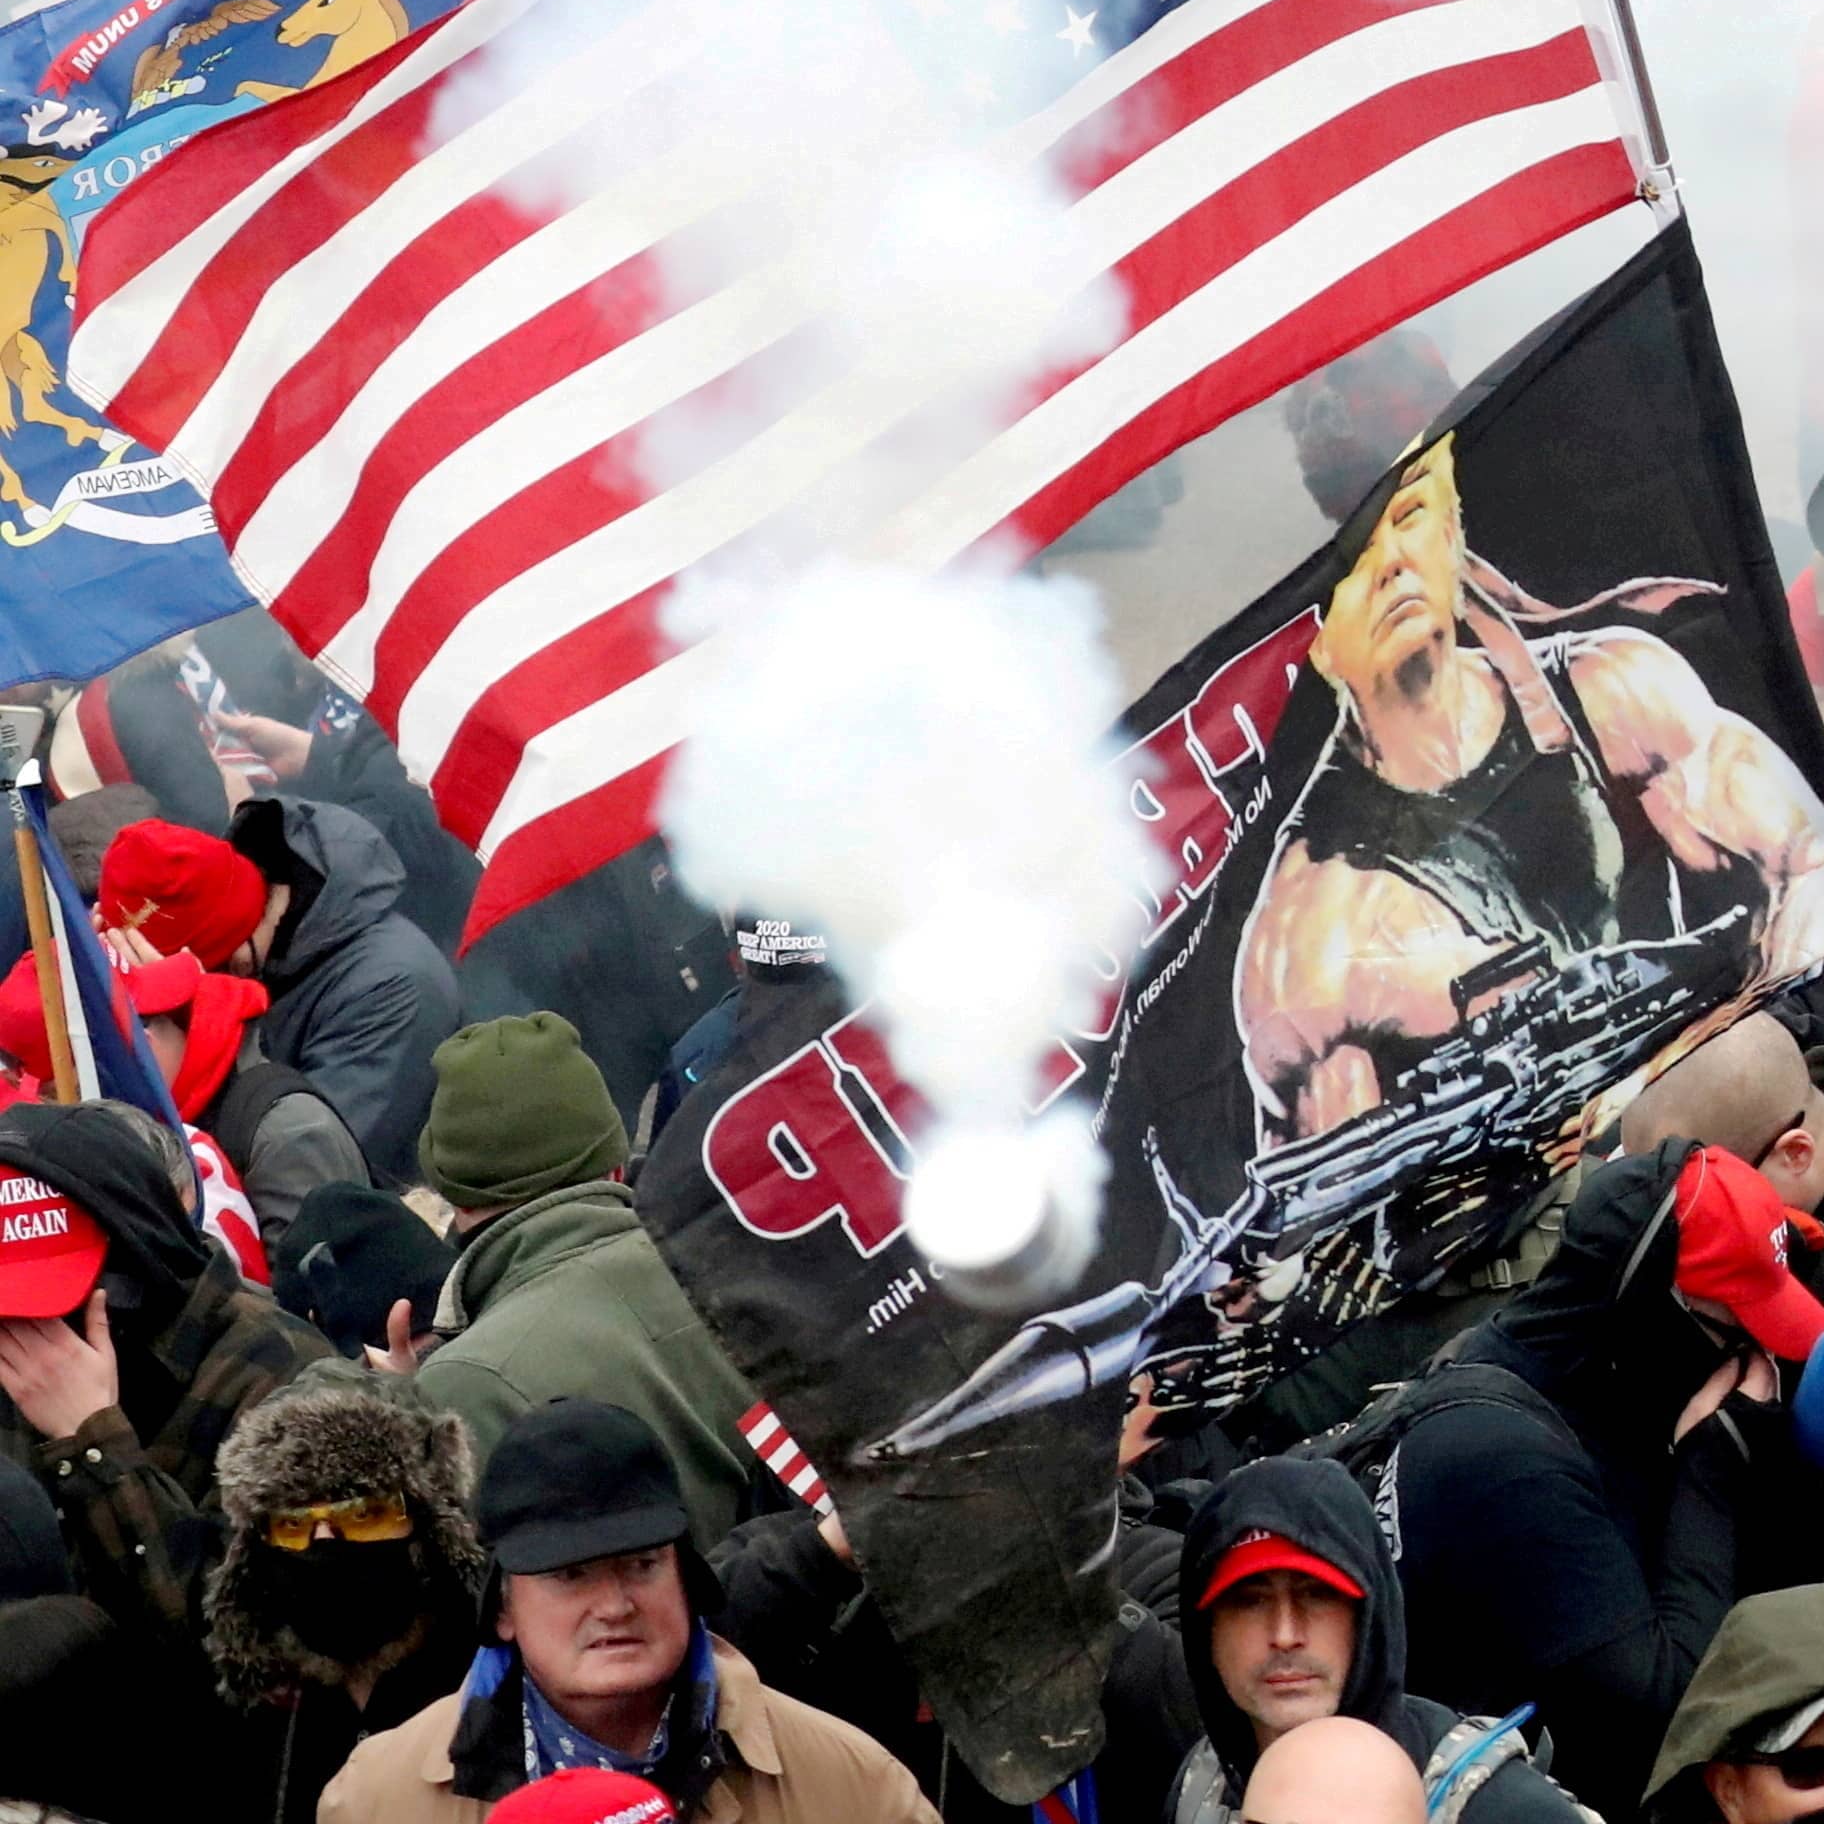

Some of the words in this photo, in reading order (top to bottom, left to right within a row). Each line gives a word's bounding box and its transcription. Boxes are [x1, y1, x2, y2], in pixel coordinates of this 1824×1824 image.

[756, 920, 791, 938] 2020
[759, 935, 828, 951] AMERICA
[1, 1208, 70, 1243] AGAIN
